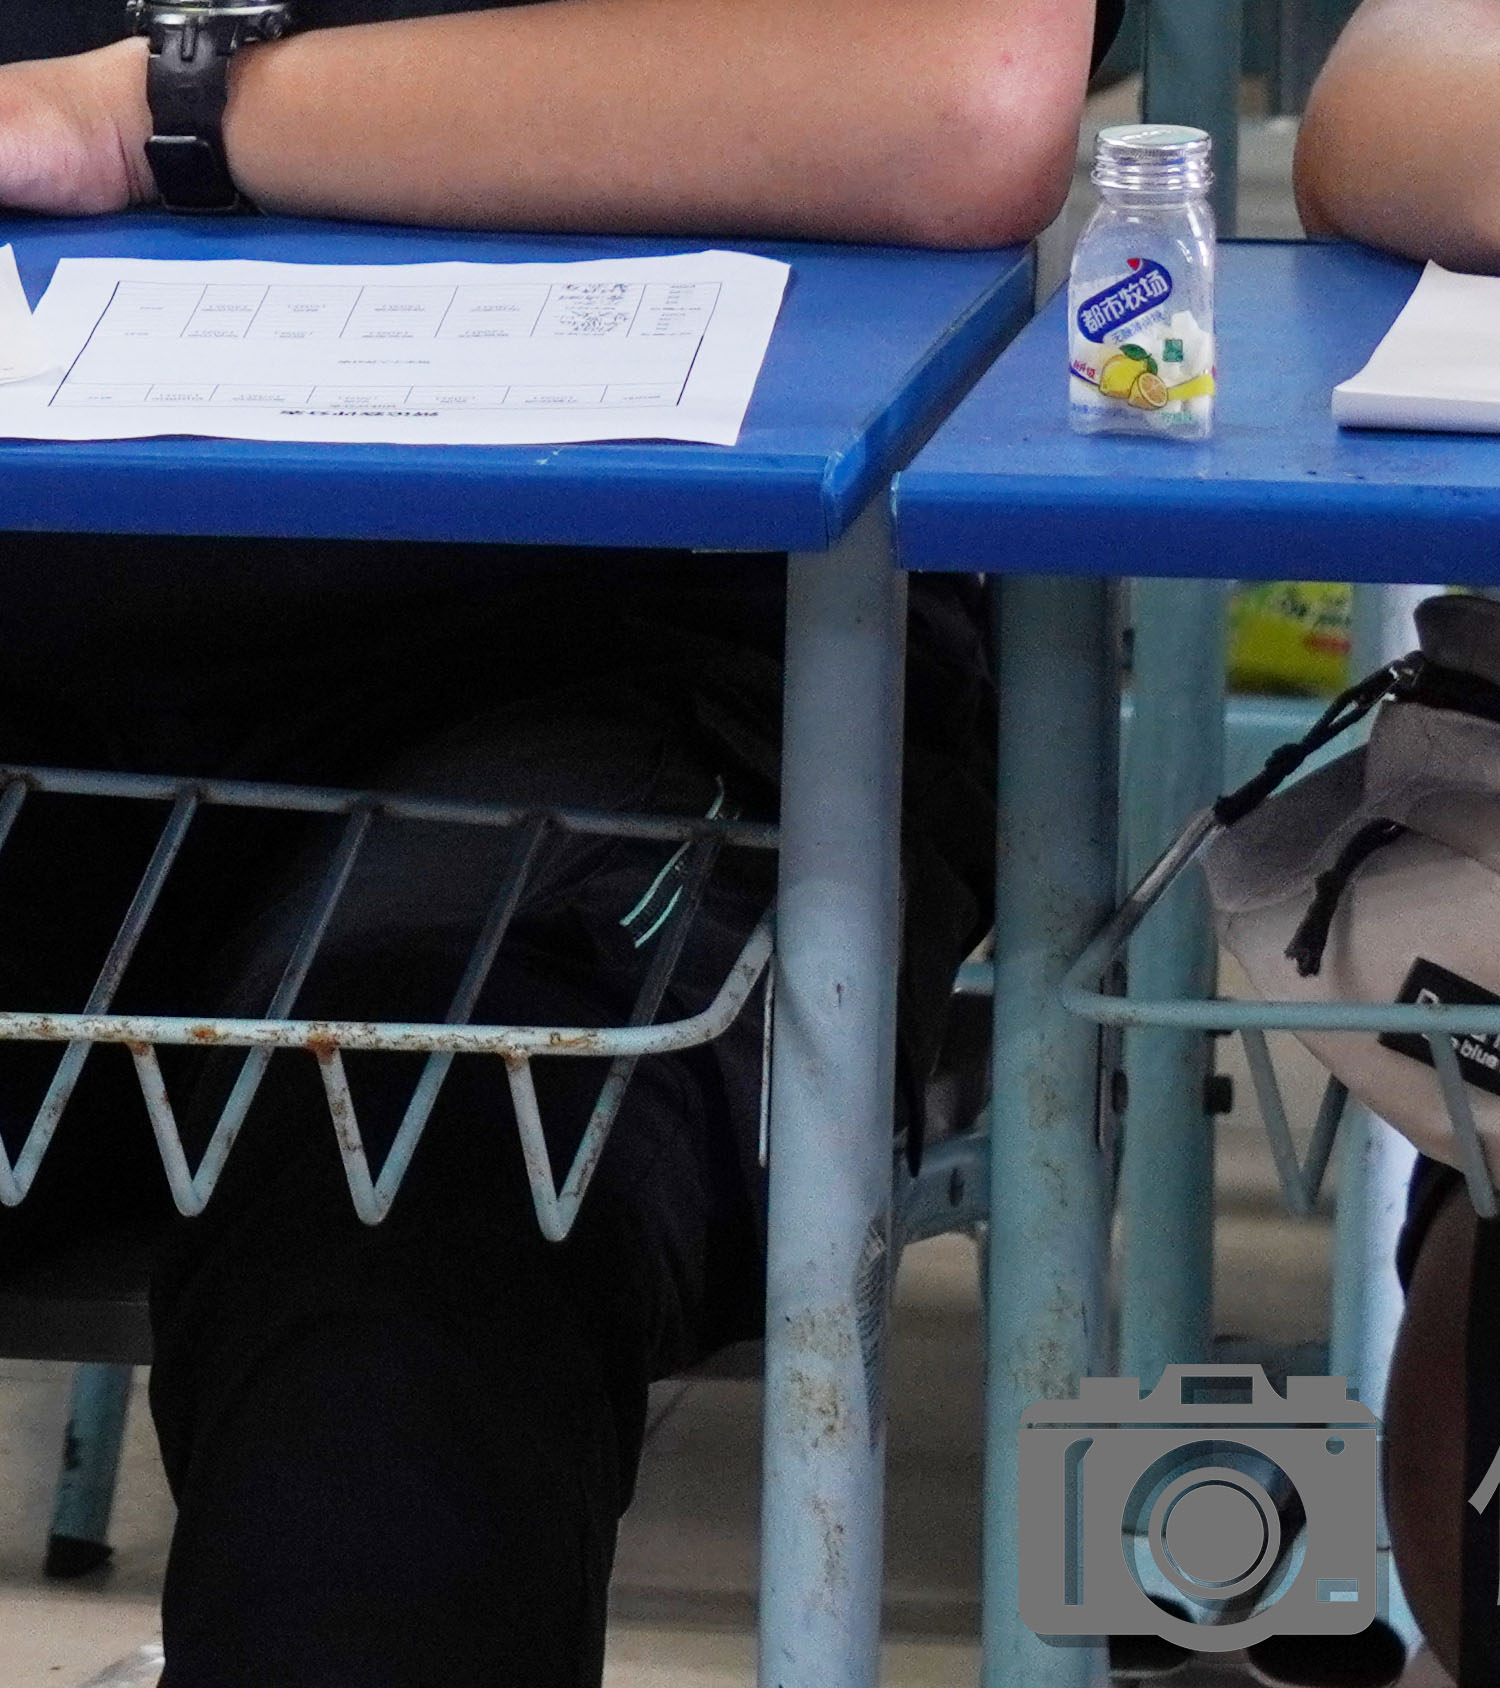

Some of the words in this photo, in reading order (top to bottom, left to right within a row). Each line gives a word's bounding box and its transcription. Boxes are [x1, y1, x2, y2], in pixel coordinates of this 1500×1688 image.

[1080, 269, 1169, 334] 都市牧场
[1459, 1037, 1500, 1071] blue
